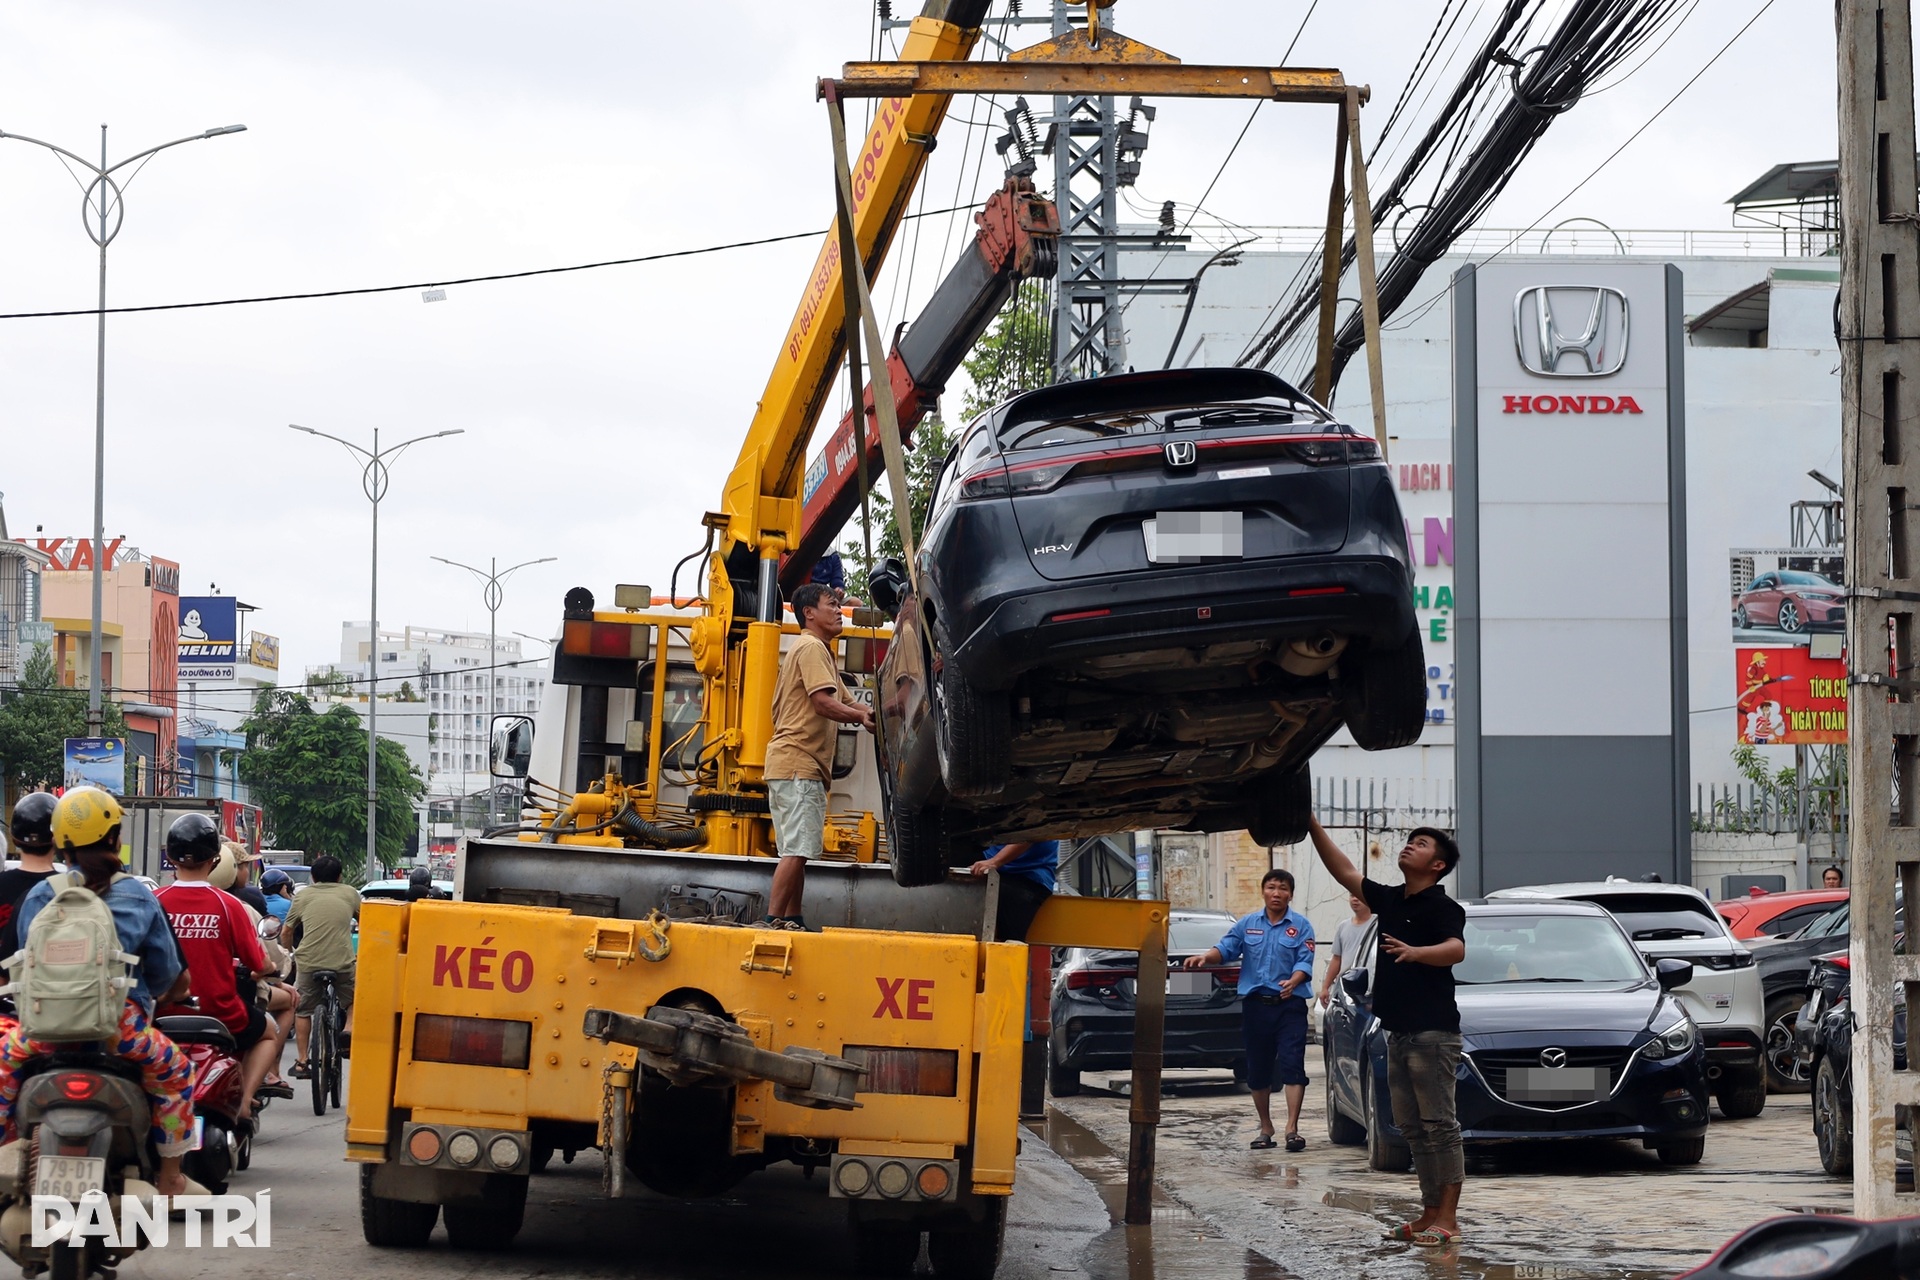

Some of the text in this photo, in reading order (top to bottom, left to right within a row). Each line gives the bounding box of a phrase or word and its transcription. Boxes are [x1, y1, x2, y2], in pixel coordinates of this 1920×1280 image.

[800, 240, 840, 338] 0911.353789
[1502, 395, 1644, 414] HONDA
[1033, 542, 1074, 556] HR-V
[1809, 675, 1832, 698] TÍCH
[1819, 707, 1845, 731] TOÀN
[174, 928, 220, 939] LETICS
[432, 936, 935, 1021] KÉO XE
[49, 1160, 94, 1179] 79-D1
